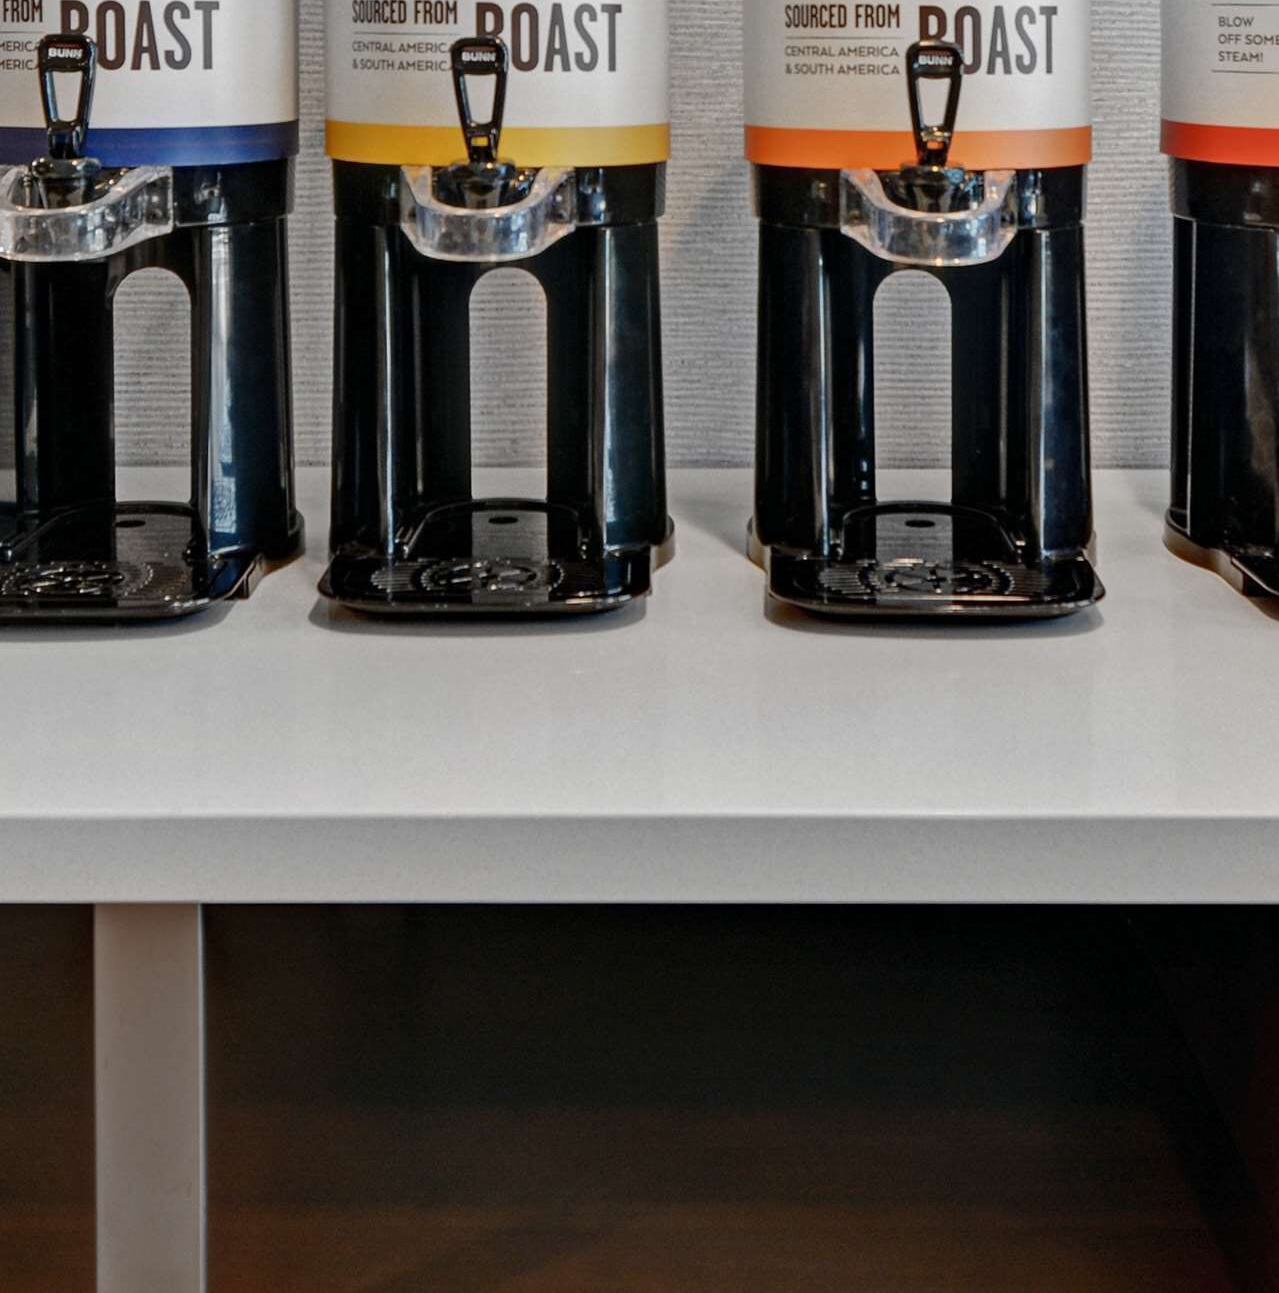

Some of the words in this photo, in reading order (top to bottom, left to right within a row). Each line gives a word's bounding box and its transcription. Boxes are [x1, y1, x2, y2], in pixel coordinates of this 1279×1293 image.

[352, 0, 407, 24] SOURCED
[414, 0, 458, 25] FROM
[785, 4, 847, 29] SOURCED
[855, 4, 900, 29] FROM
[1218, 16, 1255, 28] BLOW
[1218, 33, 1241, 46] OFF
[48, 47, 83, 59] BUNN
[352, 41, 395, 53] CENTRAL
[398, 42, 451, 54] AMERIC
[785, 45, 835, 57] CENTRAL
[838, 46, 899, 58] AMERICA
[461, 51, 496, 62] BUNN
[918, 55, 954, 66] BUNN
[1218, 50, 1264, 64] STEAM!
[360, 59, 394, 71] SOUTH
[397, 60, 451, 73] AMERIC
[794, 64, 834, 75] SOUTH
[838, 64, 900, 76] AMERICA
